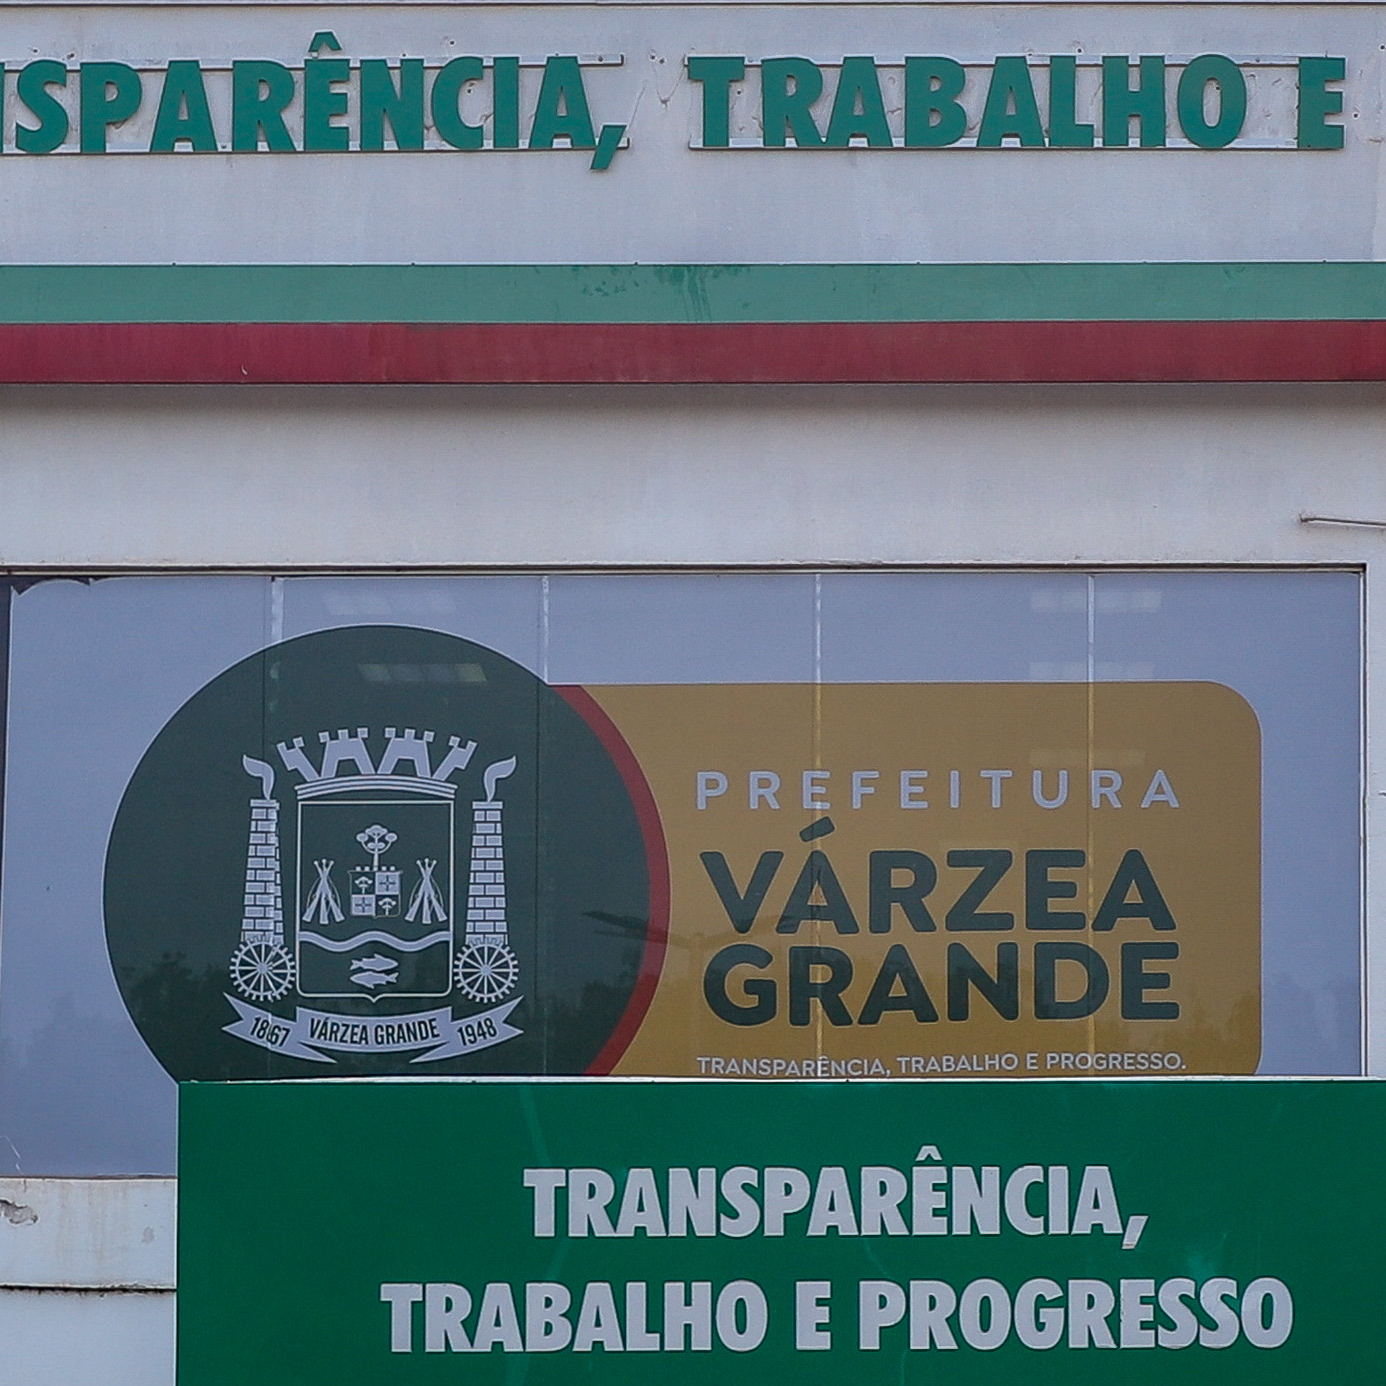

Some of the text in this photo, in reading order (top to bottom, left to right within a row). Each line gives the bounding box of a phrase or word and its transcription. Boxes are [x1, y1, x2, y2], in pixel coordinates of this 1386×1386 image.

[687, 54, 1247, 150] TRABALHO
[1297, 56, 1346, 150] E
[696, 769, 1179, 810] PREFEITURA
[700, 816, 1177, 934] VÁRZEA
[703, 941, 1180, 1026] GRANDE
[249, 1015, 498, 1048] 1867 VÁRZEA GRANDE 1948
[696, 1052, 1187, 1078] TRANSPARÊNCIA, TRABALHO E PROGRESSO.
[523, 1145, 1149, 1250] TRANSPARÊNCIA,
[379, 1277, 1294, 1353] TRABALHO E PROGRESSO
